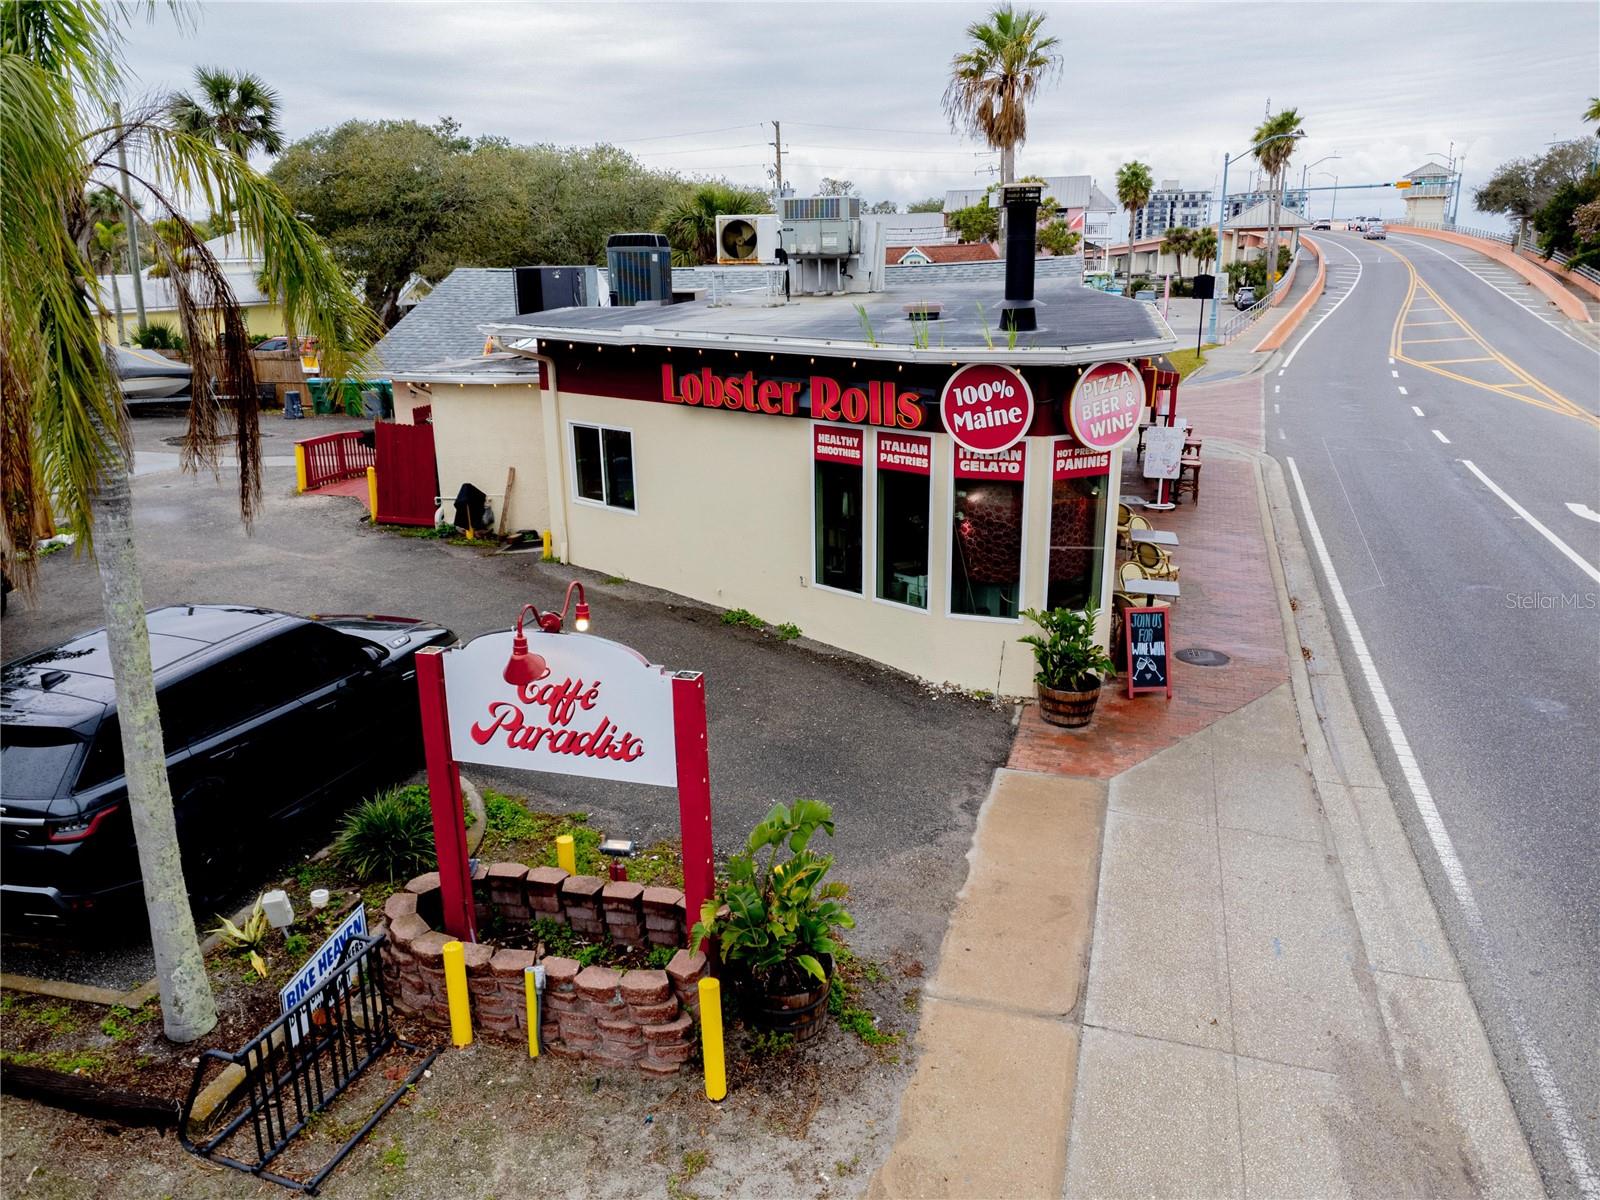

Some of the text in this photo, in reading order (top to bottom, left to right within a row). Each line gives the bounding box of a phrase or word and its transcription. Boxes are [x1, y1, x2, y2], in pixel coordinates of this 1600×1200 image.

[661, 363, 924, 429] Lobster Rolls
[953, 380, 1015, 407] 100%
[1082, 371, 1132, 400] PIZZA
[1082, 391, 1136, 421] BEER &
[953, 405, 1023, 433] Maine
[1090, 412, 1134, 438] WINE
[818, 433, 860, 448] HEALTHY
[880, 439, 928, 456] ITALIAN
[816, 445, 861, 459] SMOOTHIES
[880, 452, 929, 468] PASTRIES
[1056, 448, 1073, 458] HOT
[1056, 454, 1109, 472] PANINIS
[960, 460, 1020, 474] GELATO
[1131, 612, 1163, 629] JOIN US
[1138, 629, 1154, 642] FOR
[517, 678, 602, 726] Caffé
[471, 702, 645, 762] Paradiso
[285, 966, 316, 1010] BIKE
[317, 915, 362, 977] HEAVEN
